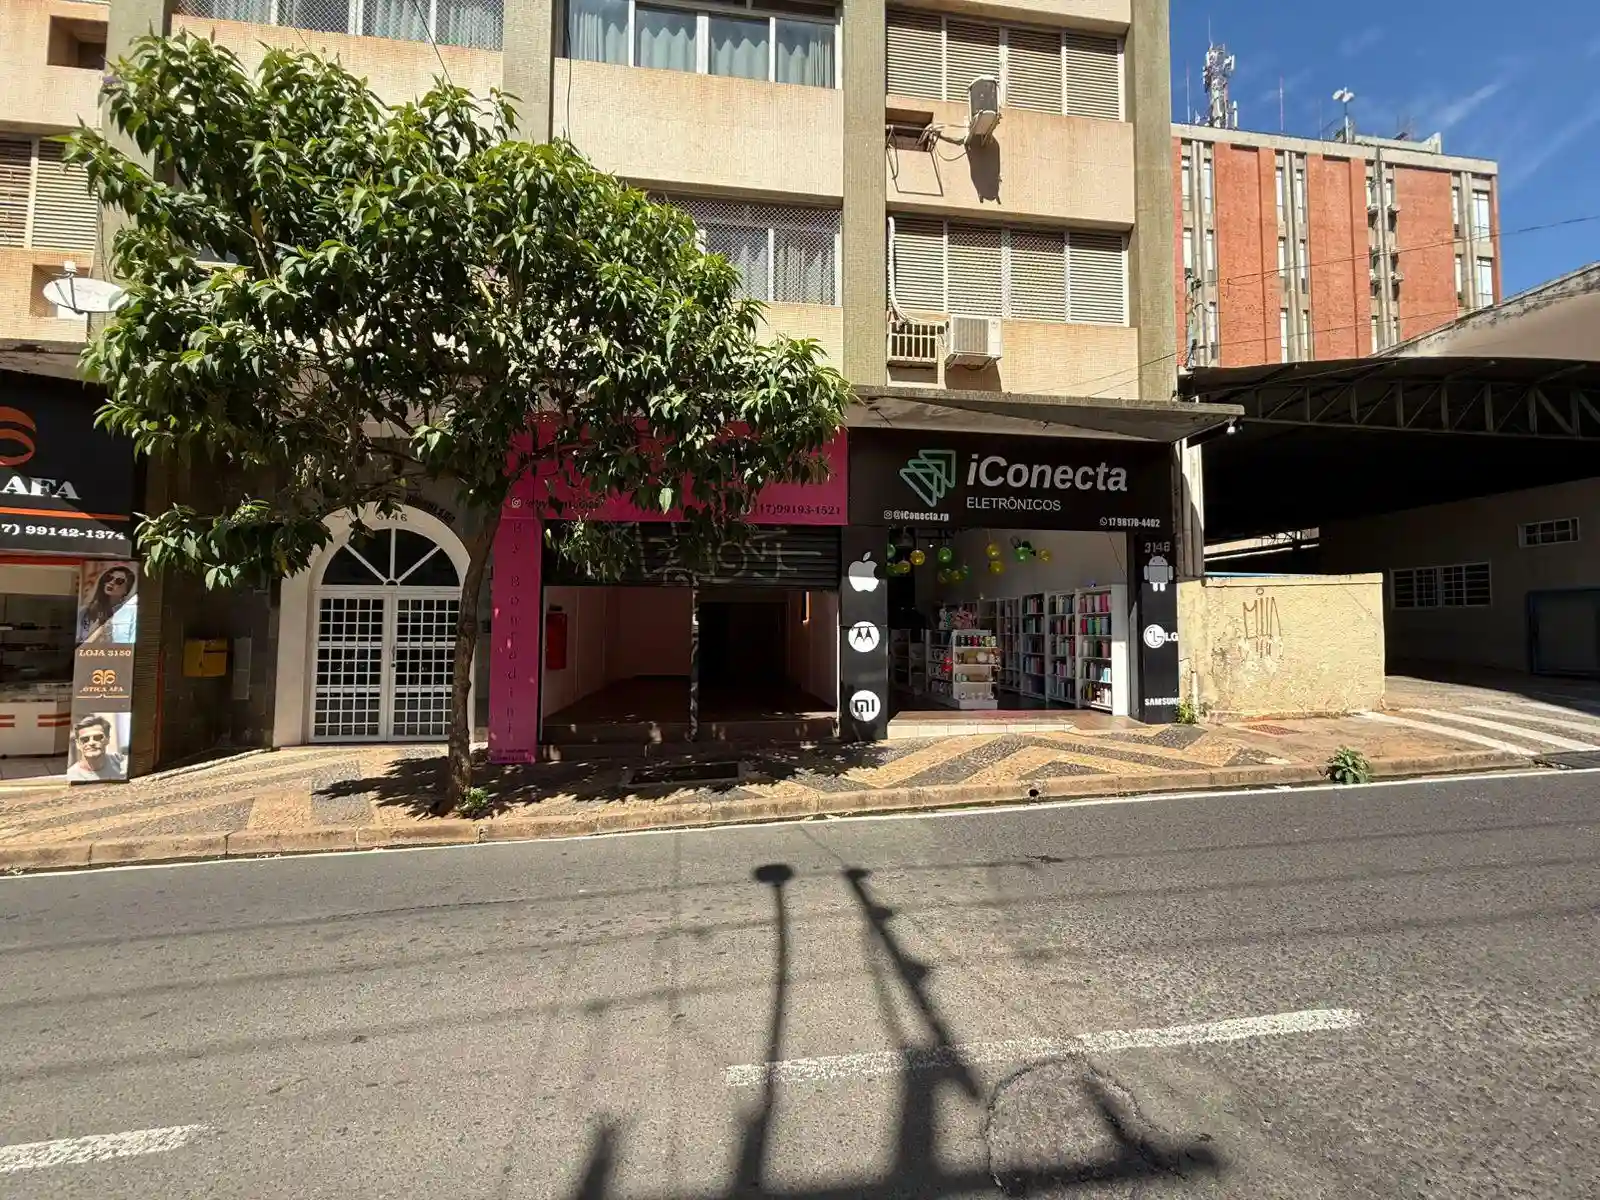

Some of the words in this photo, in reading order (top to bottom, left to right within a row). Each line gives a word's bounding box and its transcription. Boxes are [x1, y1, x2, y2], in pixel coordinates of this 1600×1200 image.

[966, 454, 1128, 492] iConecta
[0, 475, 81, 500] AFA
[966, 496, 1061, 511] ELETRÔNICOS
[25, 525, 126, 541] 99142-1374
[1164, 631, 1179, 642] LG
